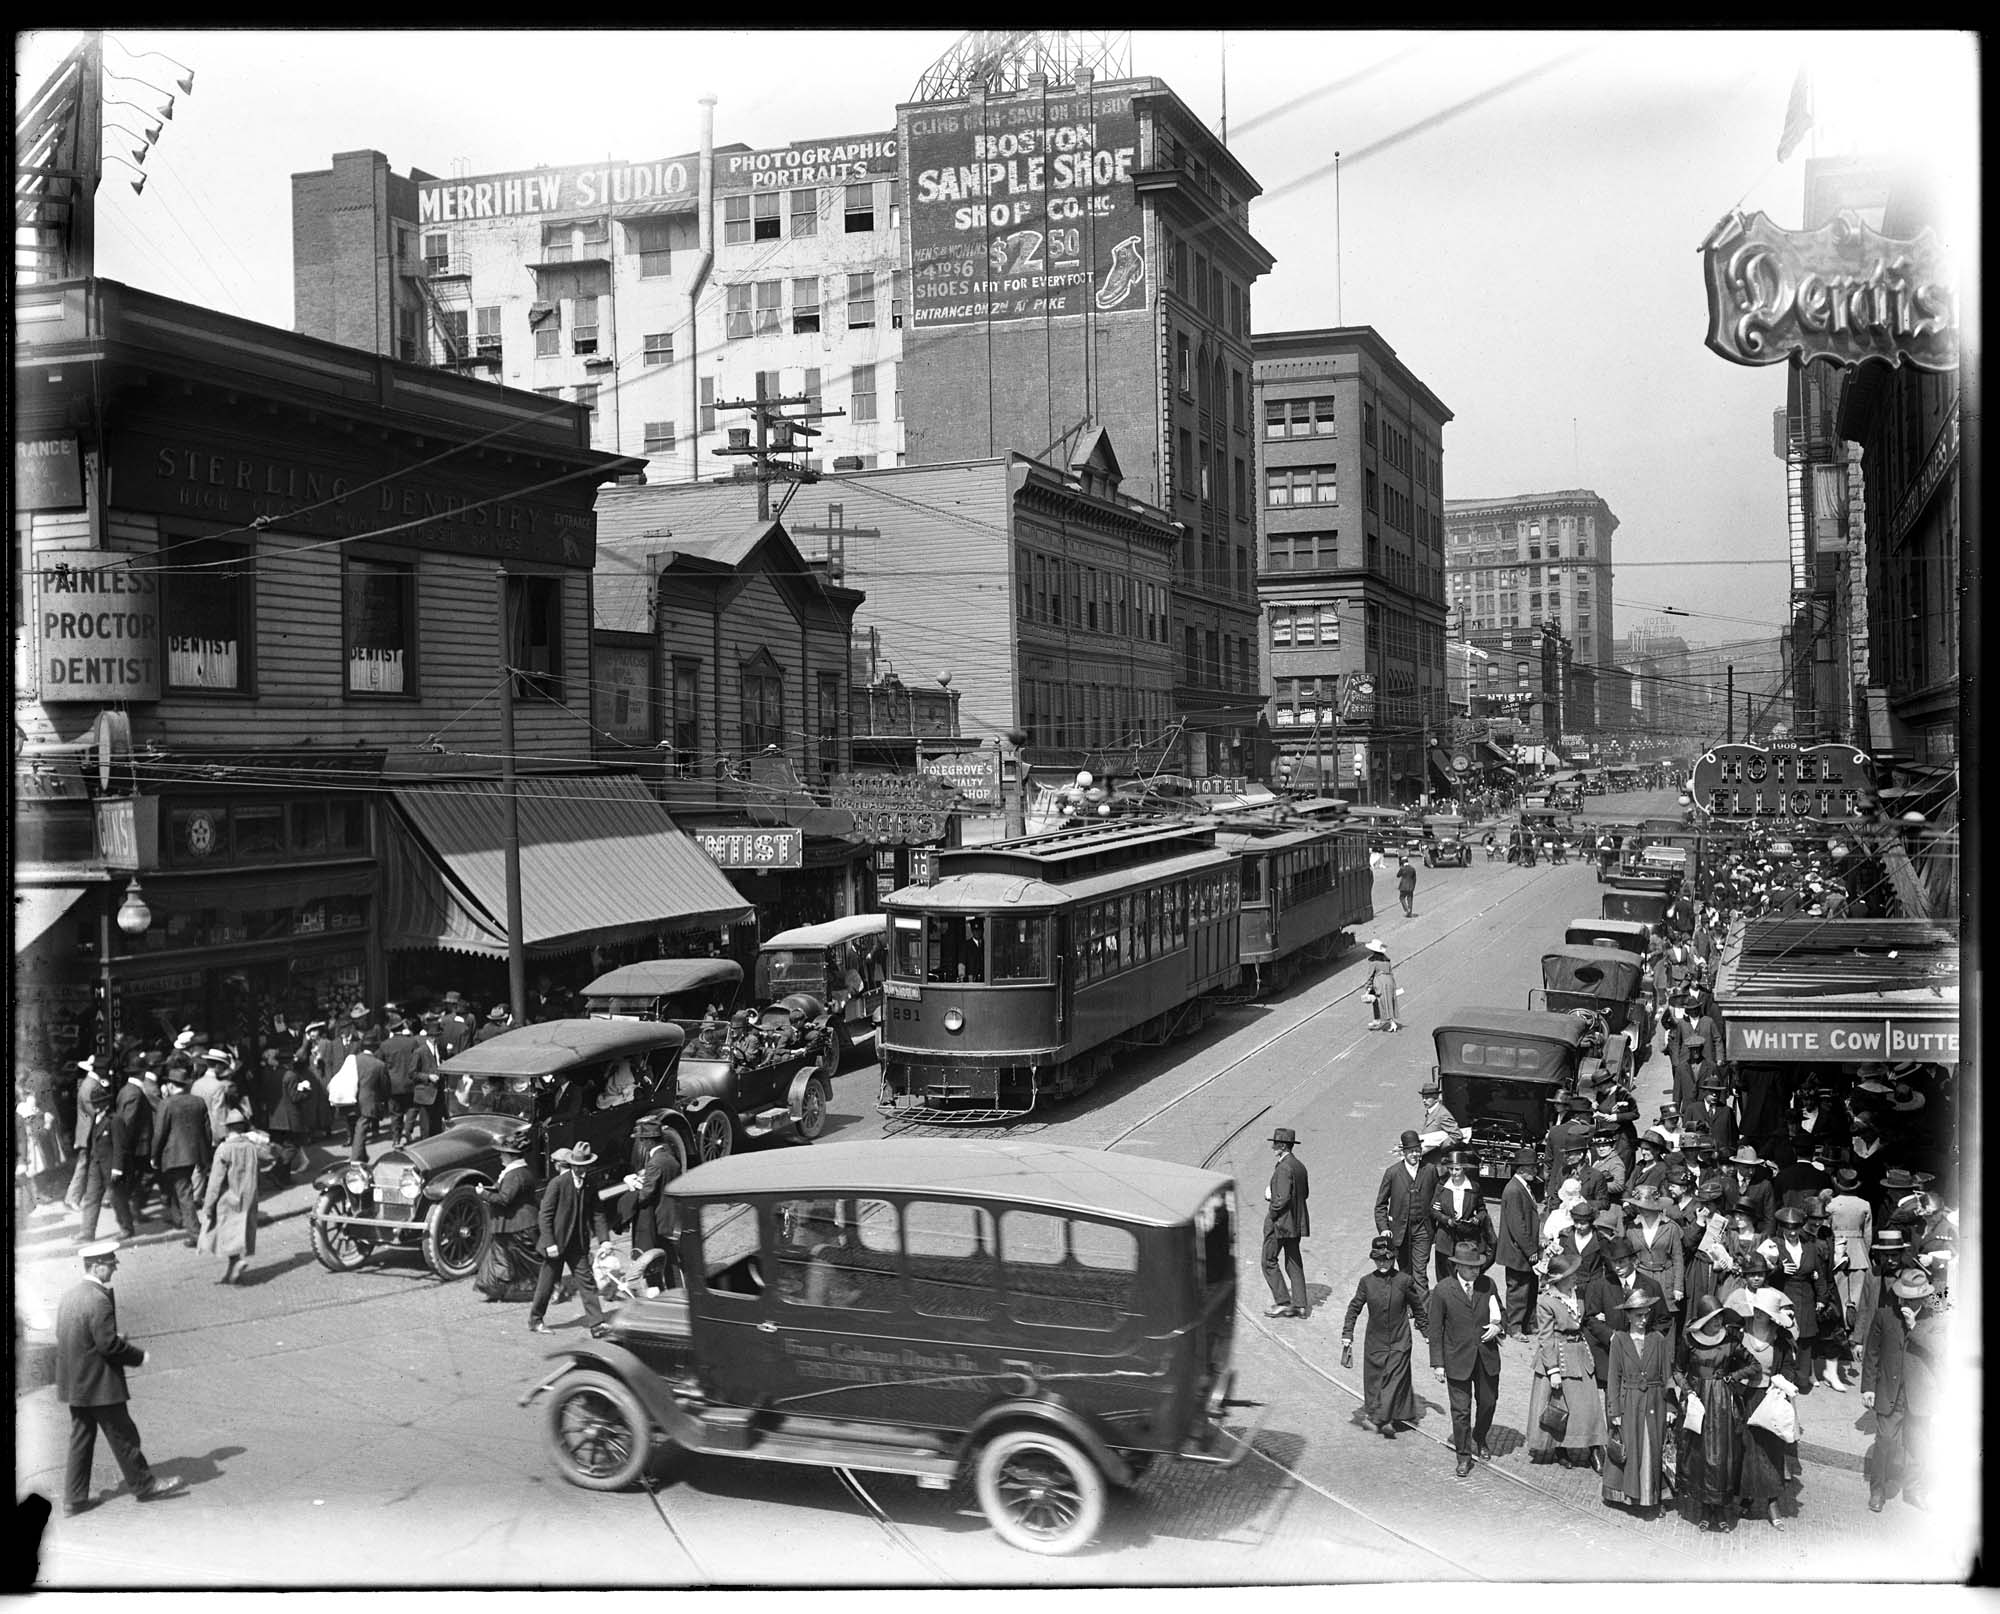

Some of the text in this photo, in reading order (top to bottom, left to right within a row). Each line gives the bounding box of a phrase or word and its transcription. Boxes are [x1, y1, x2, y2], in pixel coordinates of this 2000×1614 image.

[974, 123, 1097, 160] BOSTON
[729, 139, 897, 173] PHOTOGRAPHIC
[752, 161, 868, 188] PORTRAITS
[918, 147, 1135, 202] SAMPLE SHOE
[418, 162, 687, 223] MERRIHEW STUDIO
[955, 201, 1032, 230] SHOP
[1046, 197, 1084, 220] CO.
[953, 260, 974, 278] $6
[916, 281, 970, 298] SHOES
[973, 282, 980, 293] A
[1003, 278, 1028, 291] FOR
[915, 304, 973, 320] ENTRANCE
[1033, 297, 1066, 310] PIKE
[159, 447, 543, 535] STERLING DENTISTRY
[43, 567, 156, 594] PAINLESS
[44, 612, 156, 639] PROCTOR
[171, 637, 232, 655] DENTIST
[351, 648, 400, 662] DENTIST
[50, 657, 153, 684] DENTIST
[1721, 754, 1843, 784] HOTEL
[1709, 788, 1858, 818] ELLIOTT
[857, 812, 935, 834] HOES
[695, 834, 794, 864] NTIST
[1742, 1028, 1959, 1051] WHITE COW BUTTE
